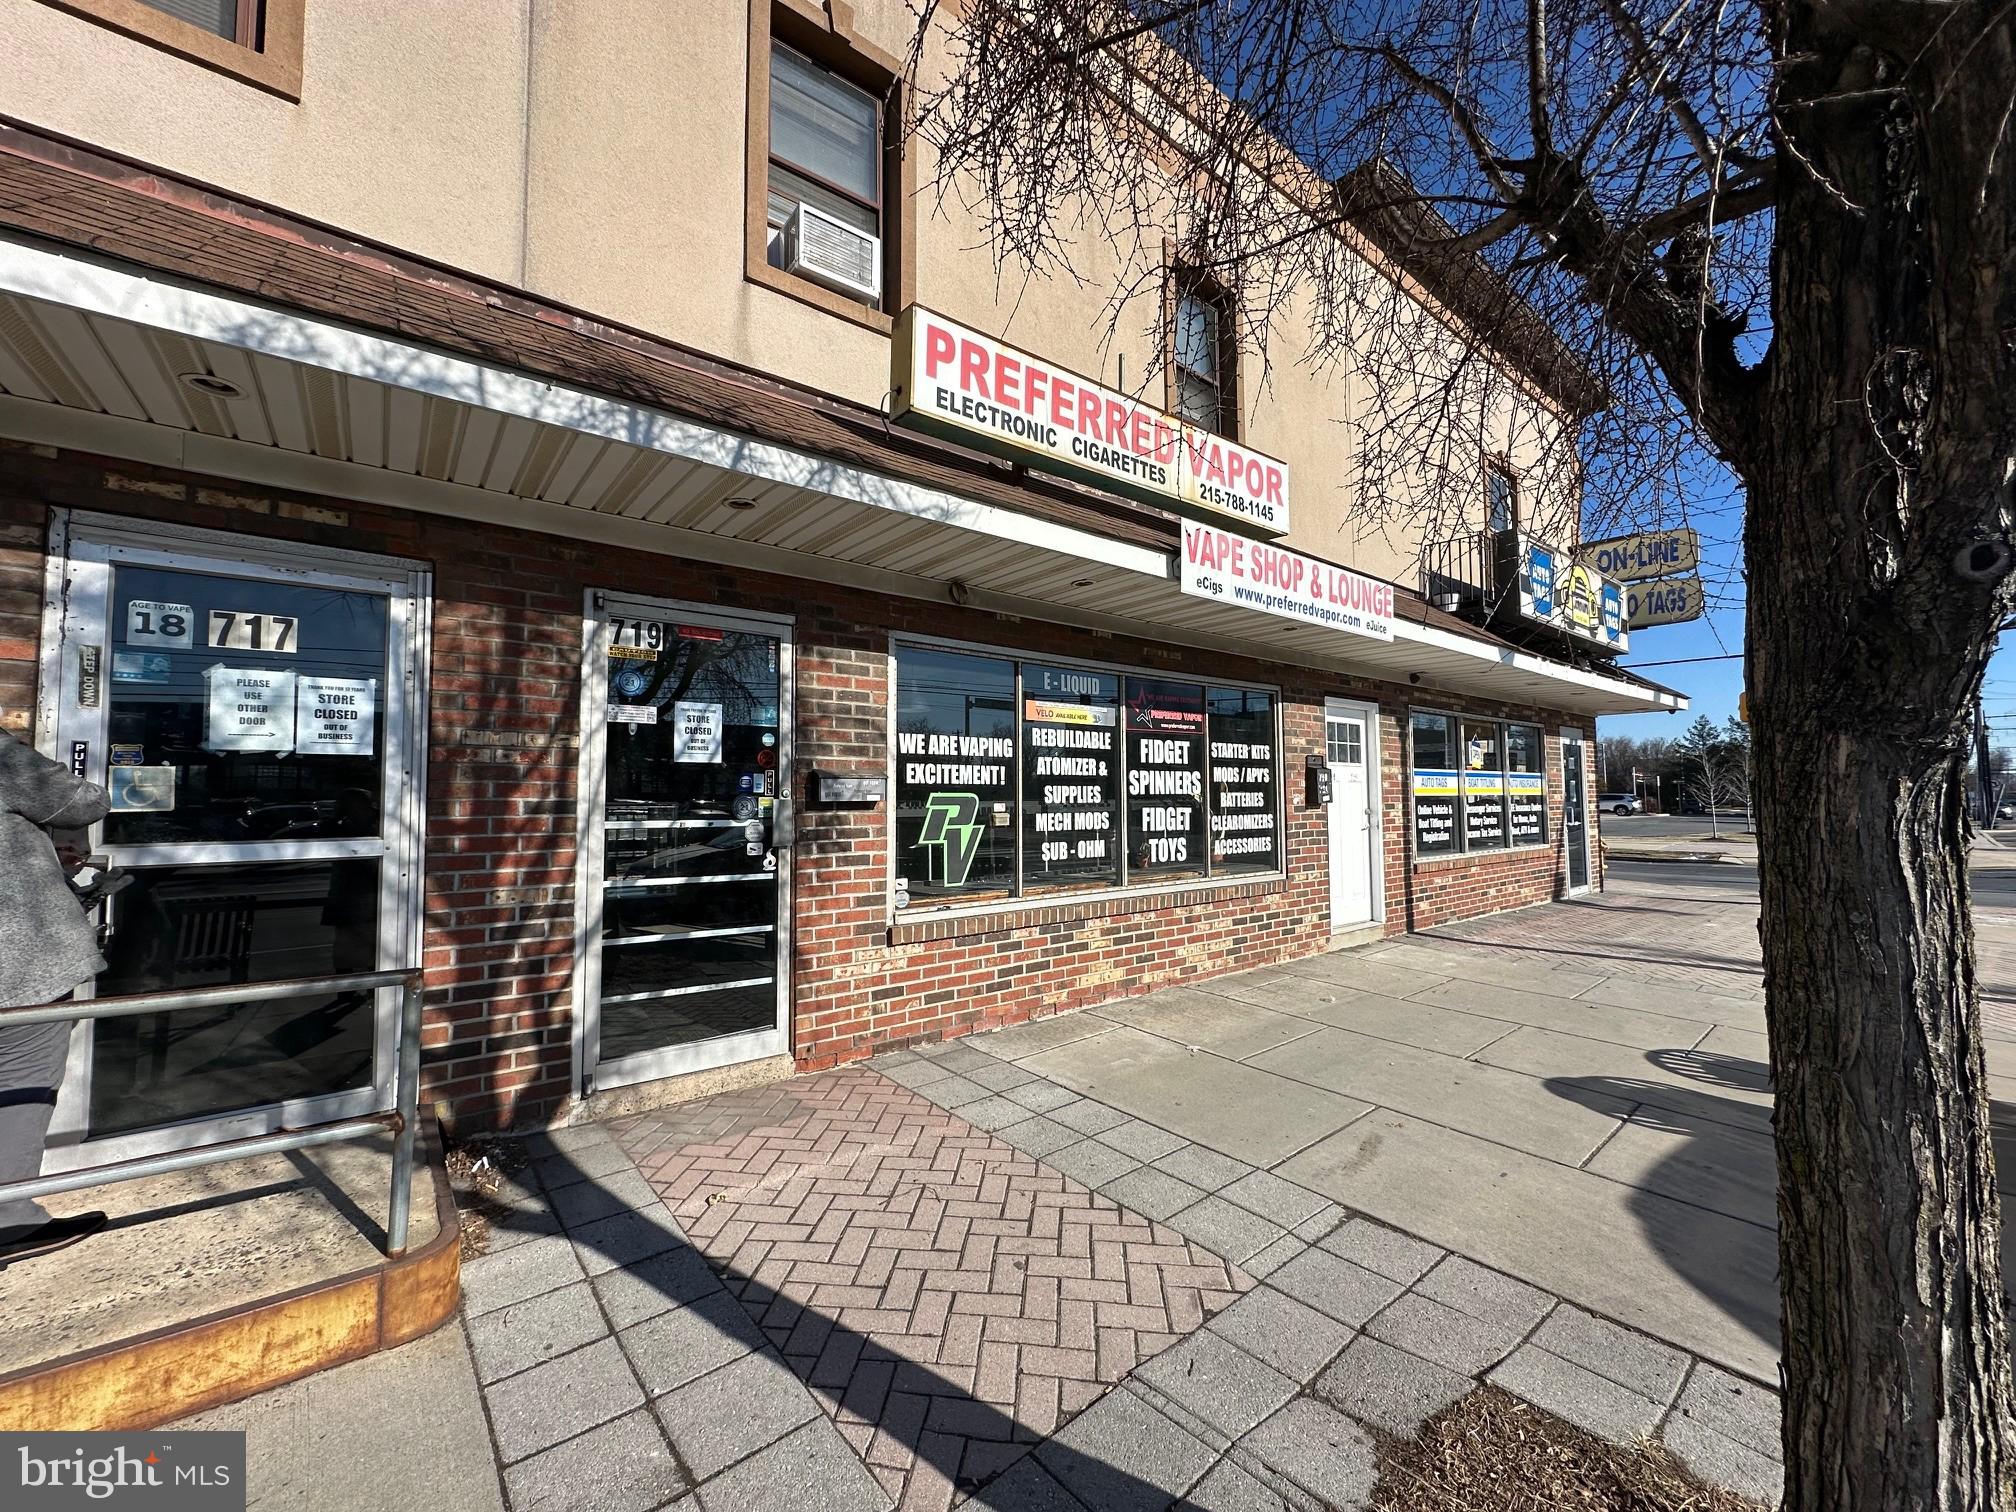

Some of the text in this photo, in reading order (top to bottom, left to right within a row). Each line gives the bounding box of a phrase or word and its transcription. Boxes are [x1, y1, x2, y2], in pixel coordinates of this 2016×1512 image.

[926, 323, 1284, 507] PREFERRED VAPOR
[936, 386, 1166, 485] ELECTRONIC CIGARETTES
[1200, 483, 1274, 521] 215-788-1145
[1597, 537, 1681, 573] ON-LINE
[1185, 526, 1392, 619] VAPE SHOP & LOUNGE
[131, 601, 151, 609] AGE
[167, 605, 192, 613] VAPE
[1196, 576, 1387, 634] eCigs www.preferredvapor.com eJuice
[1604, 597, 1619, 616] AUTO
[1646, 586, 1687, 616] TAGS
[134, 611, 186, 637] 18
[213, 611, 295, 651] 717
[610, 618, 662, 649] 719
[83, 677, 96, 706] DOWN
[236, 678, 271, 688] PLEASE
[1043, 672, 1051, 690] E
[1060, 673, 1100, 695] LIQUID
[244, 691, 263, 700] USE
[318, 693, 355, 705] STORE
[237, 704, 268, 713] OTHER
[314, 708, 358, 720] CLOSED
[1036, 708, 1054, 718] VELO
[1056, 712, 1077, 720] AVAILABLE
[239, 717, 266, 726] DOOR
[686, 714, 710, 723] STORE
[684, 726, 712, 735] CLOSED
[1032, 727, 1112, 750] REBUILDABLE
[899, 733, 1014, 758] WE ARE VAPING
[1140, 738, 1191, 765] FIDGET
[1211, 741, 1271, 760] STARTER KITS
[74, 743, 86, 778] PULL
[1036, 756, 1108, 777] ATOMIZER &
[1129, 770, 1202, 796] SPINNERS
[1213, 766, 1240, 783] MODS
[1240, 768, 1246, 783] /
[1421, 777, 1448, 787] AUTO TAGS
[1468, 778, 1496, 787] BOAT TITLING
[1044, 785, 1102, 805] SUPPLIES
[1220, 791, 1264, 808] BATTERIES
[1417, 804, 1453, 815] Online Vehicle &
[1485, 803, 1502, 813] Services
[1035, 811, 1110, 832] MECH MODS
[1141, 806, 1193, 832] FIDGET
[1211, 813, 1274, 832] CLEAROMIZERS
[1418, 817, 1453, 830] Boat Titling and
[1470, 815, 1498, 827] Notary Service
[1422, 831, 1450, 844] Registration
[1488, 827, 1502, 836] Service
[1041, 841, 1068, 861] SUB
[1077, 840, 1106, 859] OHM
[1149, 837, 1187, 863] TOYS
[1214, 836, 1272, 855] ACCESSORIES
